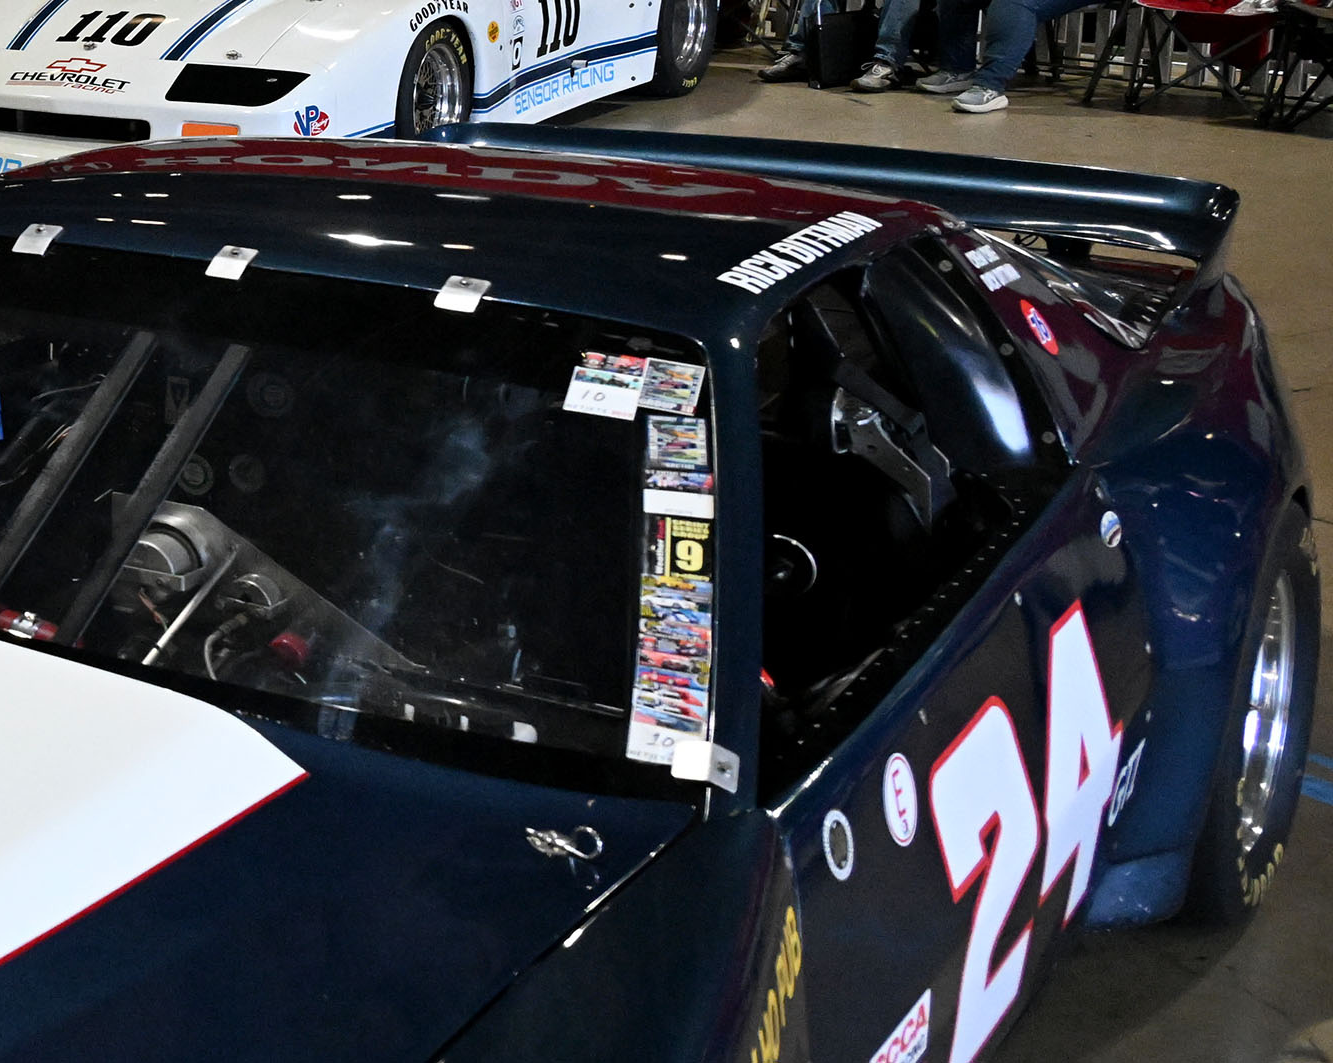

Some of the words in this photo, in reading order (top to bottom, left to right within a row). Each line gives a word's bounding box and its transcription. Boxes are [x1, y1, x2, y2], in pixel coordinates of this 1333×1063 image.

[56, 11, 166, 46] 110
[10, 72, 131, 90] CHEVROLET
[65, 83, 117, 94] racing
[514, 80, 561, 114] SENSOR
[562, 62, 615, 94] RACING
[294, 105, 320, 136] VP
[716, 249, 803, 295] RICK
[930, 598, 1127, 1063] 24
